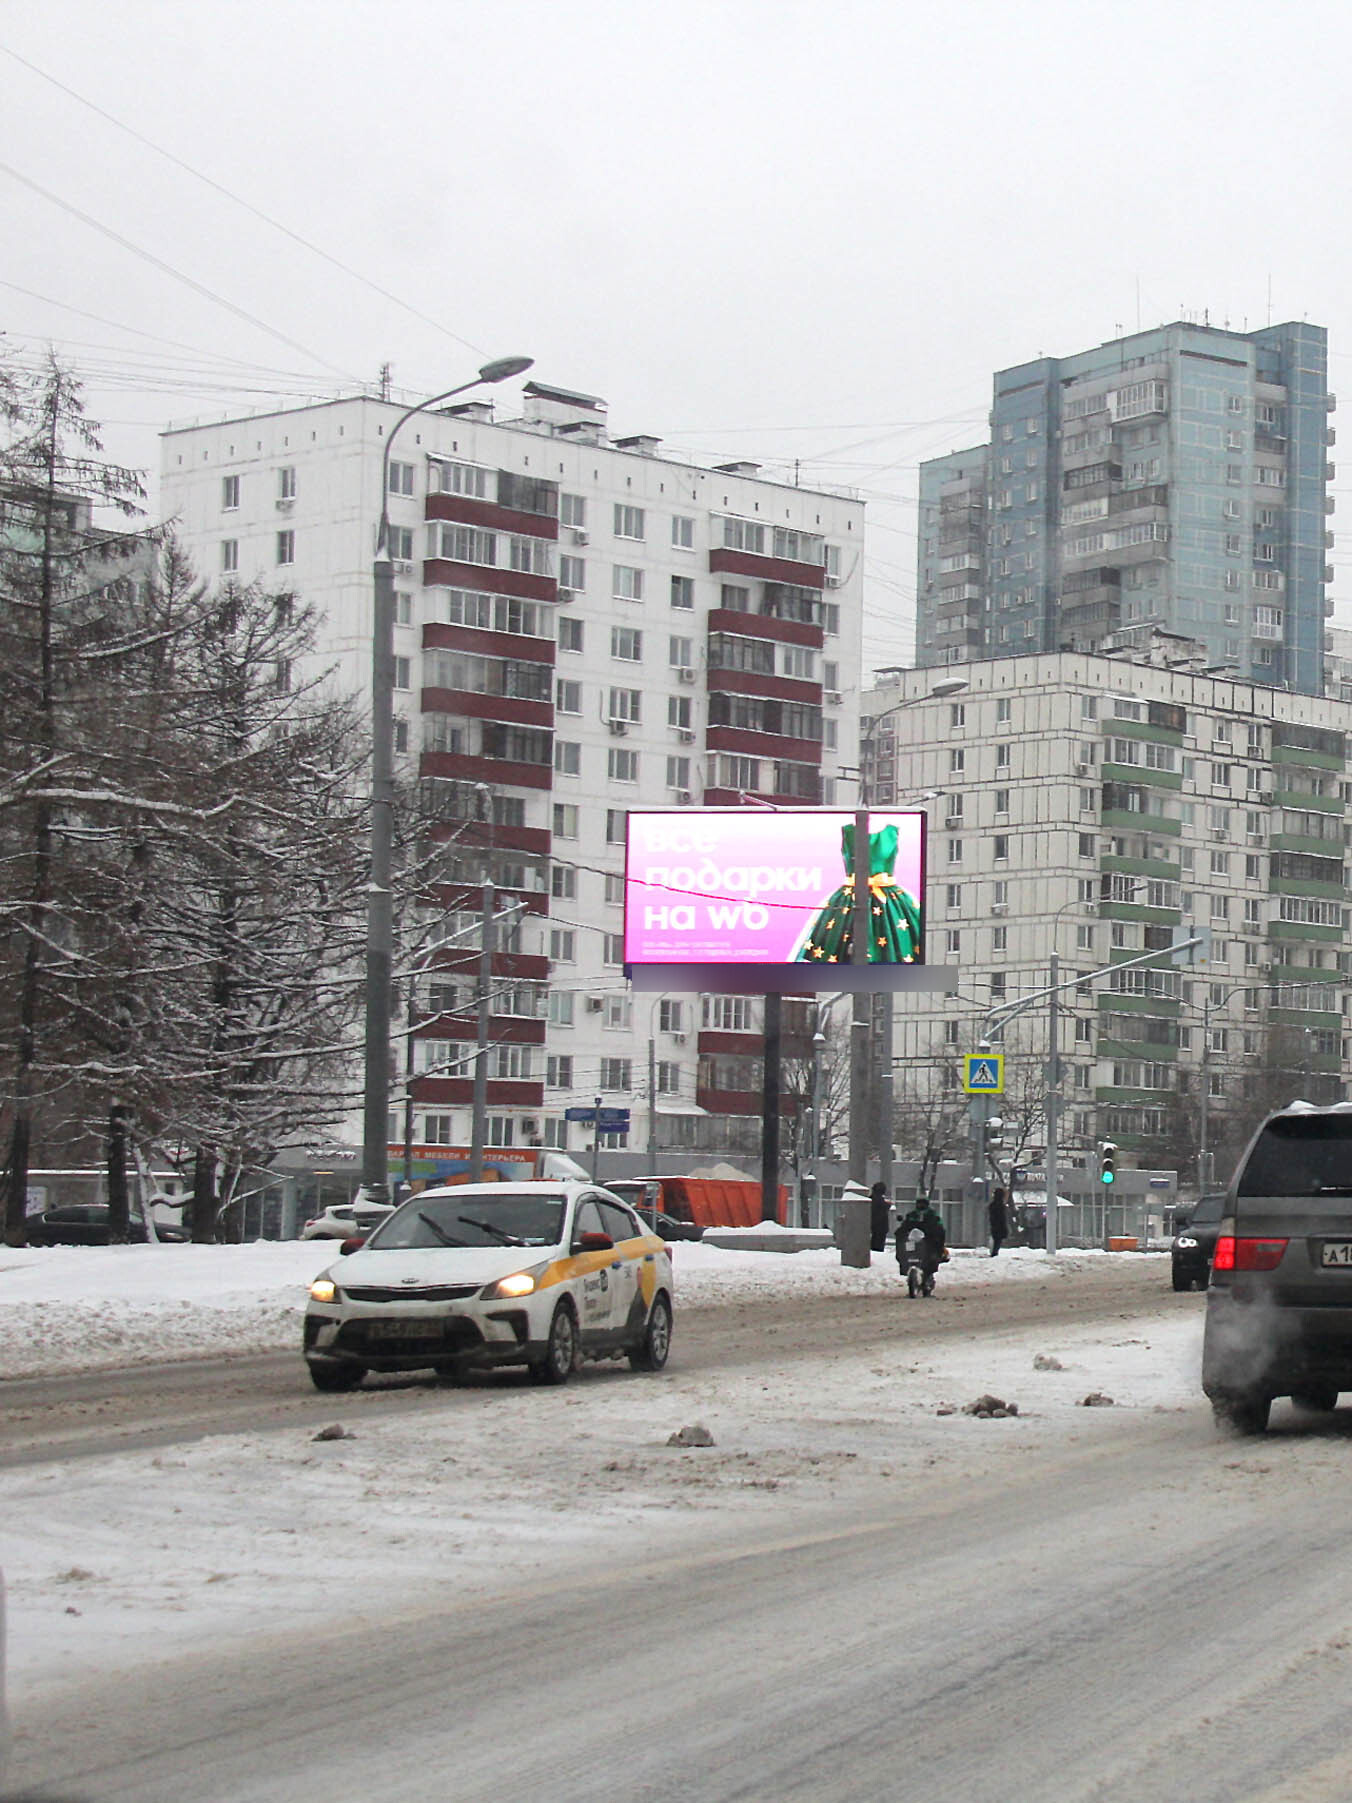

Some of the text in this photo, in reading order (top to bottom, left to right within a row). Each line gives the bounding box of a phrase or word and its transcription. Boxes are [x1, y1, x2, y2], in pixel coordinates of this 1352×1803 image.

[645, 857, 823, 898] подарки
[644, 905, 696, 930] на
[481, 1154, 526, 1162] НТЕРЬЕРА
